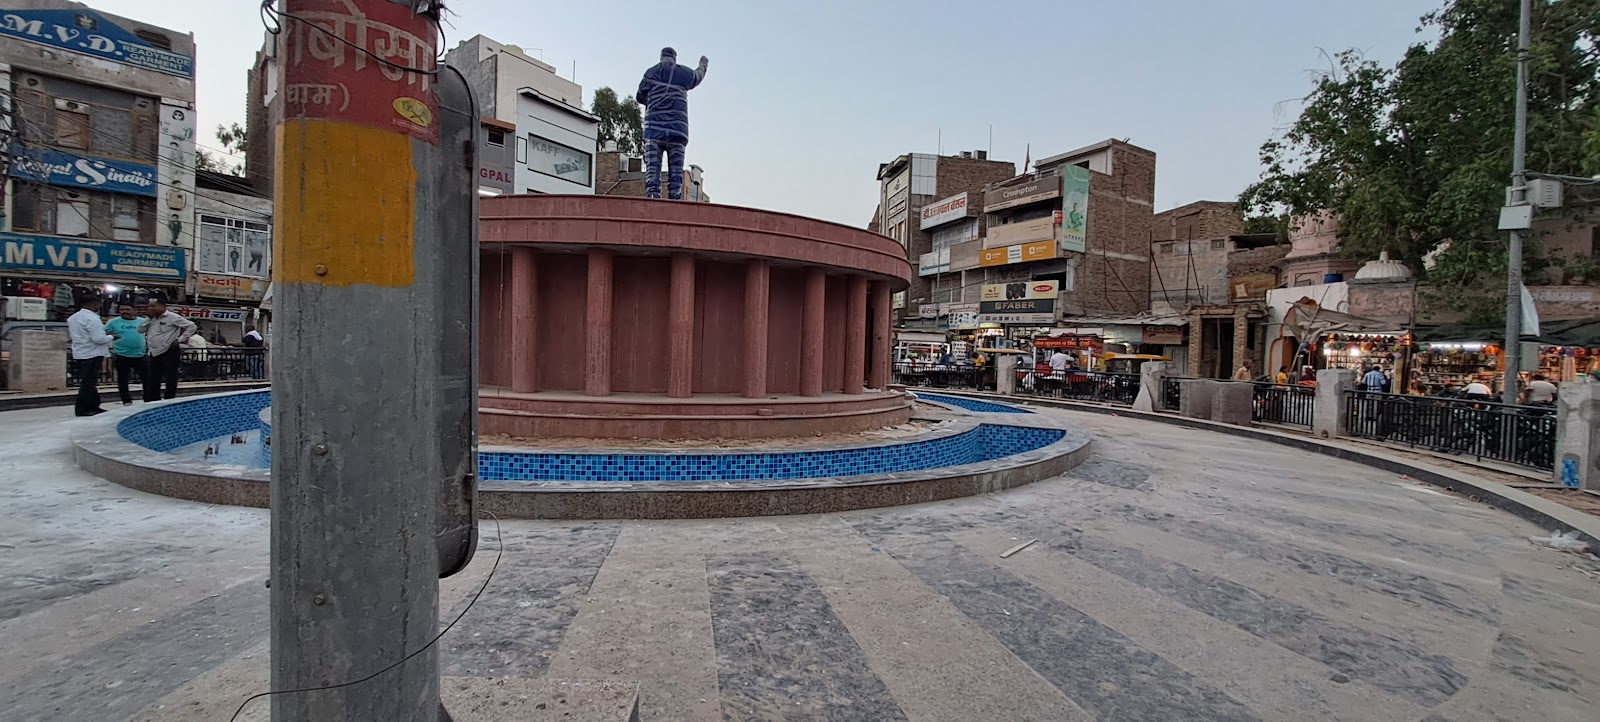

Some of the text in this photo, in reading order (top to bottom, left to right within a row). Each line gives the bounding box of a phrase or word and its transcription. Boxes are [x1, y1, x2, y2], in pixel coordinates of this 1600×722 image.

[122, 45, 191, 67] READYMADE
[130, 53, 183, 70] GARMENT
[532, 141, 561, 156] KAFF
[75, 158, 153, 187] Sindhi
[1002, 185, 1038, 198] Crompton
[110, 249, 176, 261] READYMADE
[117, 258, 170, 268] GARMENT
[1002, 301, 1035, 310] FABER
[212, 310, 241, 319] चाट
